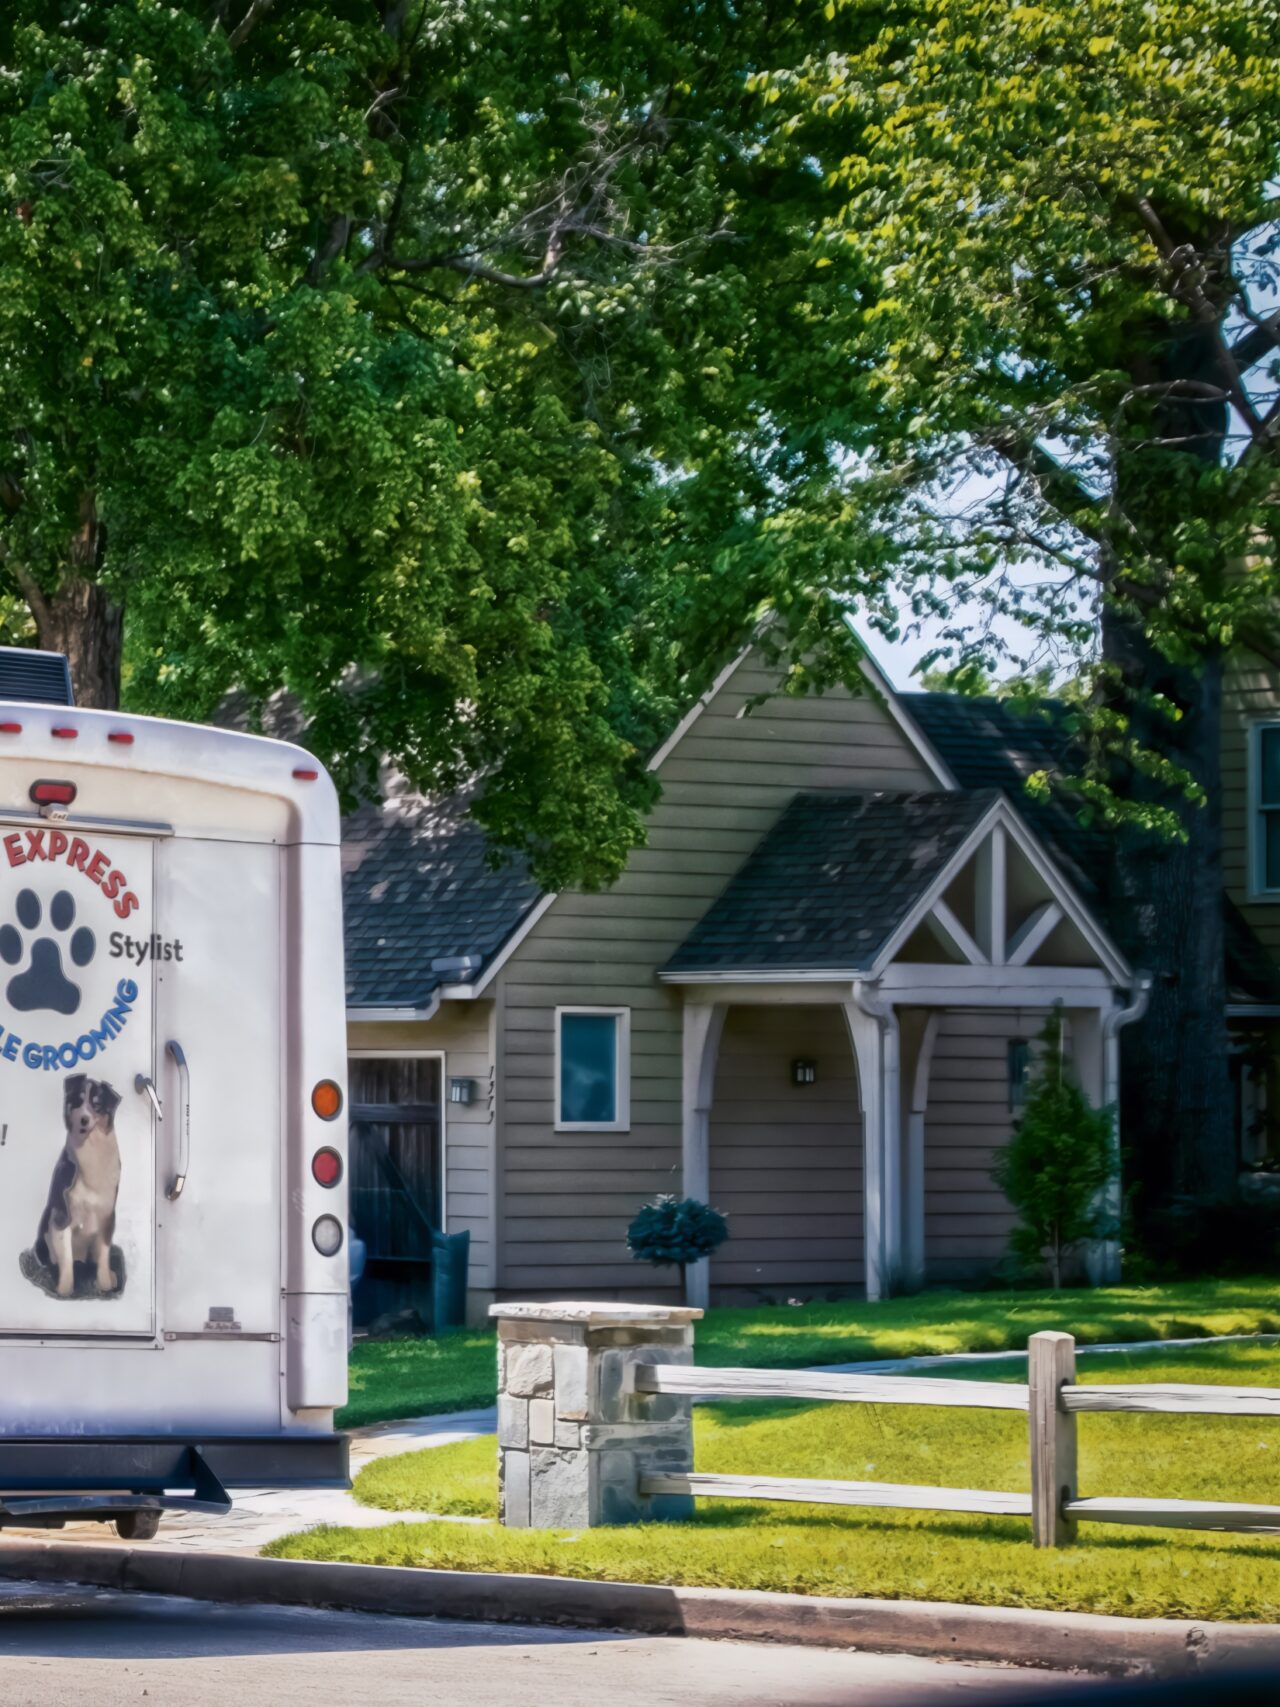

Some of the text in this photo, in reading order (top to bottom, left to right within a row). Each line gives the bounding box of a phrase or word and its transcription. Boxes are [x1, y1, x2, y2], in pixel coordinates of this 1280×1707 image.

[3, 830, 139, 919] EXPRESS
[109, 932, 184, 966] Stylist
[23, 978, 138, 1071] GROOMING
